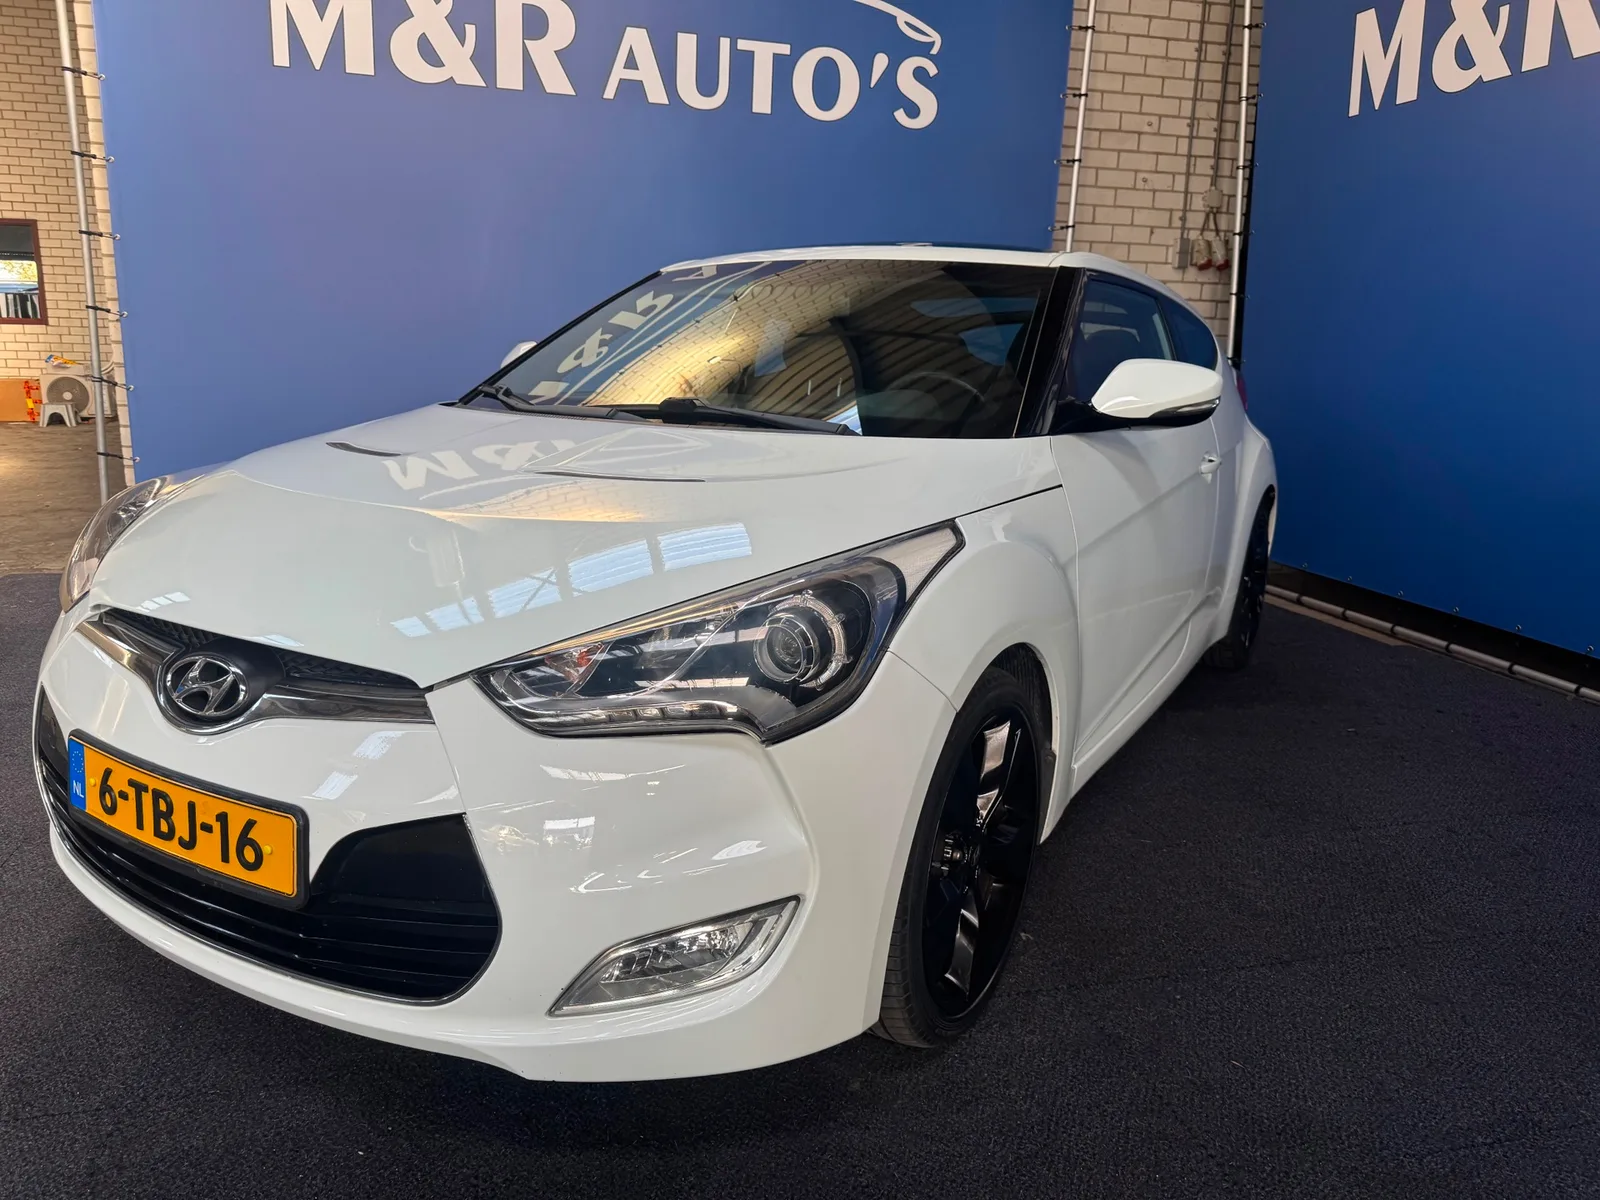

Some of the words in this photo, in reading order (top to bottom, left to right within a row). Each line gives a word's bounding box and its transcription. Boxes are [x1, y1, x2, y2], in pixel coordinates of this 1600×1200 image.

[269, 0, 577, 96] M&R
[602, 26, 940, 130] AUTO'S
[72, 779, 85, 798] NL
[98, 767, 264, 872] 6-TBJ-16
